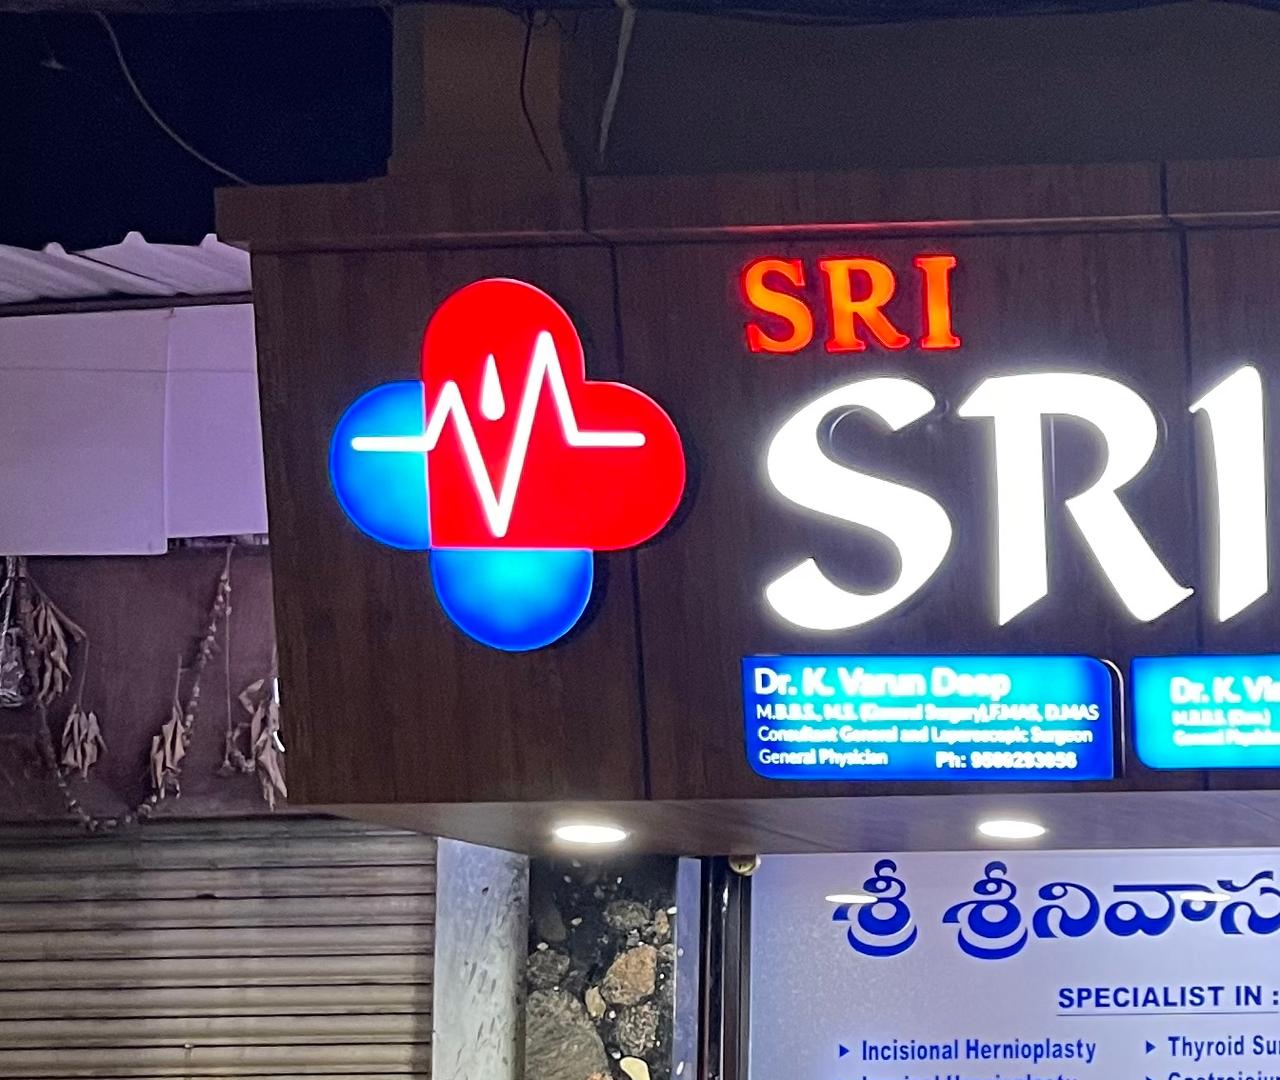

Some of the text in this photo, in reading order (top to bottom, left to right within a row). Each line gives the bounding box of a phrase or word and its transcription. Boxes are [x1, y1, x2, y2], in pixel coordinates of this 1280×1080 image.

[742, 256, 960, 352] SRI
[755, 668, 796, 695] Dr.
[1171, 678, 1208, 703] Dr.
[759, 727, 838, 742] Consultant
[1031, 727, 1092, 745] Surgeon
[760, 750, 816, 764] General
[819, 749, 887, 767] Physician
[1059, 986, 1224, 1008] SPECIALIST
[1236, 986, 1261, 1006] IN
[863, 1038, 1096, 1064] Incisional Hernioplasty
[1168, 1035, 1244, 1061] Thyroid
